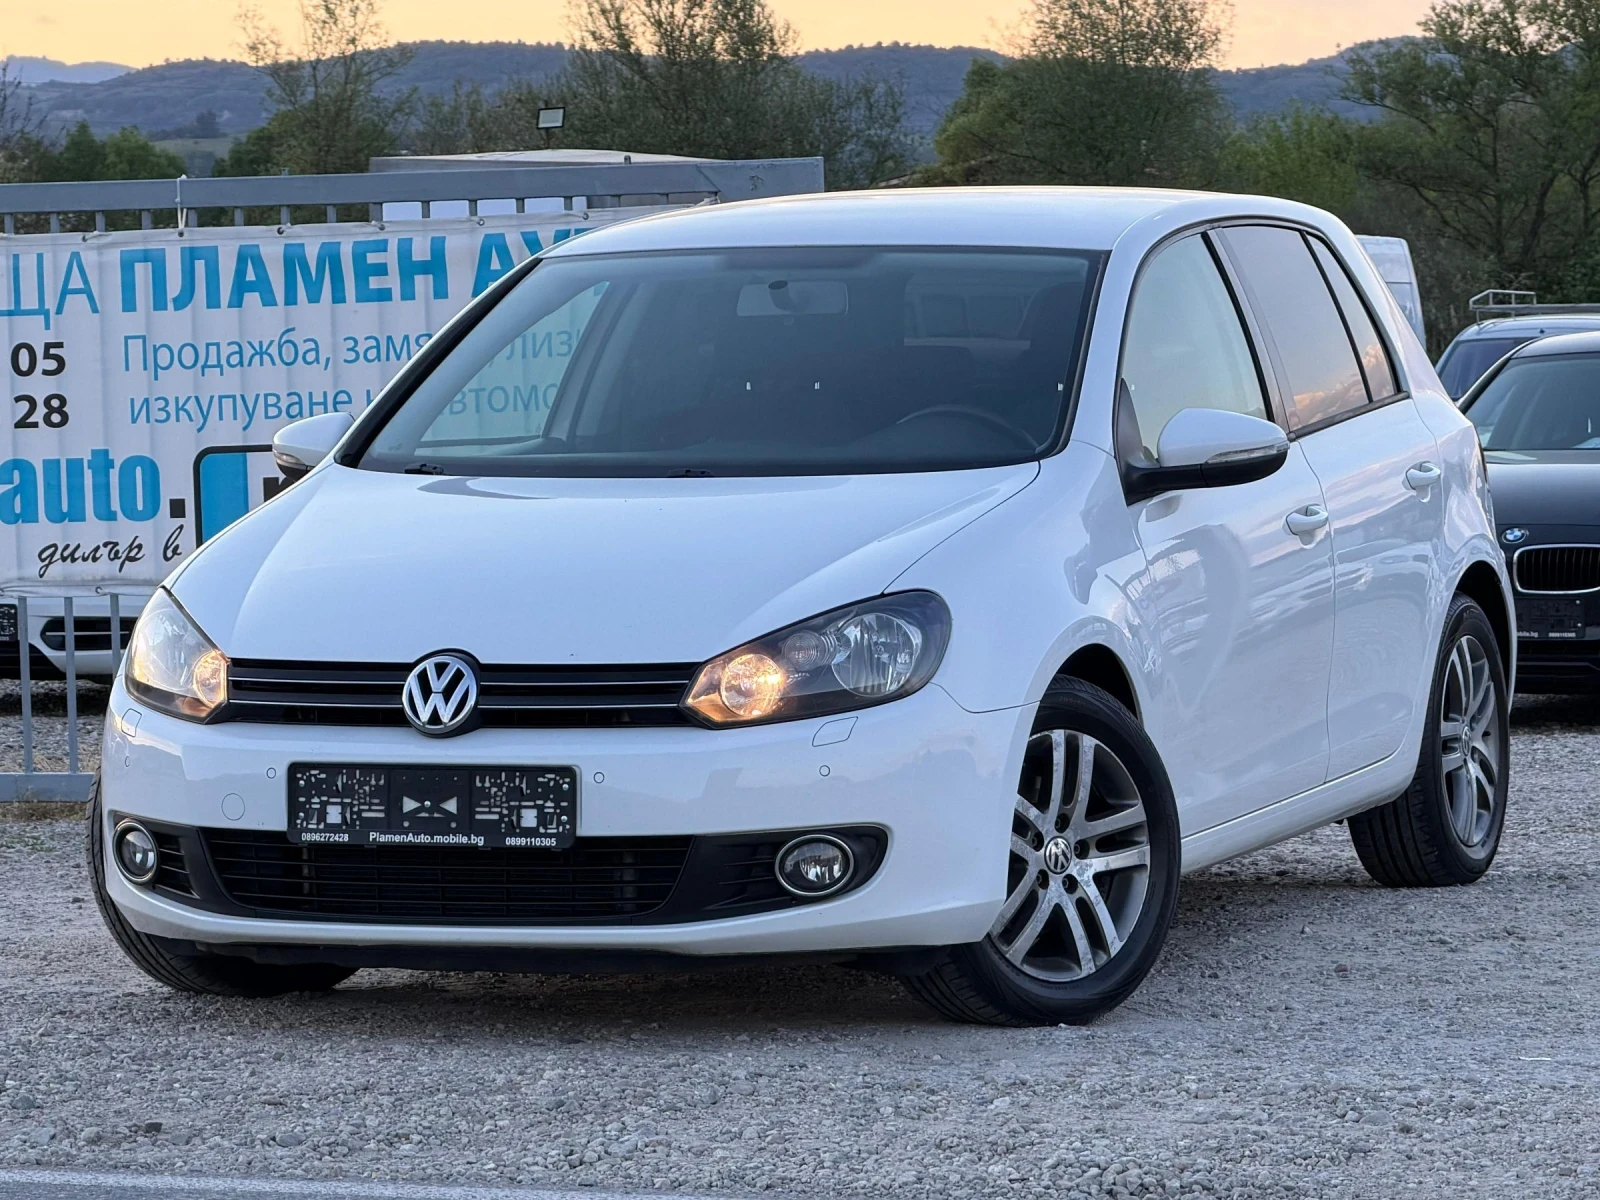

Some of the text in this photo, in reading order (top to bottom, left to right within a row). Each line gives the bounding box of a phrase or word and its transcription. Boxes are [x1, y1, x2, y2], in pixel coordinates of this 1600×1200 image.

[120, 235, 449, 313] ПЛАМЕН
[10, 341, 66, 377] 05
[123, 327, 331, 381] Продажба,
[13, 393, 69, 429] 28
[129, 388, 353, 433] изкупуване
[301, 831, 557, 846] 0896272428 PlamenAuto.mobile.bg 0899110305
